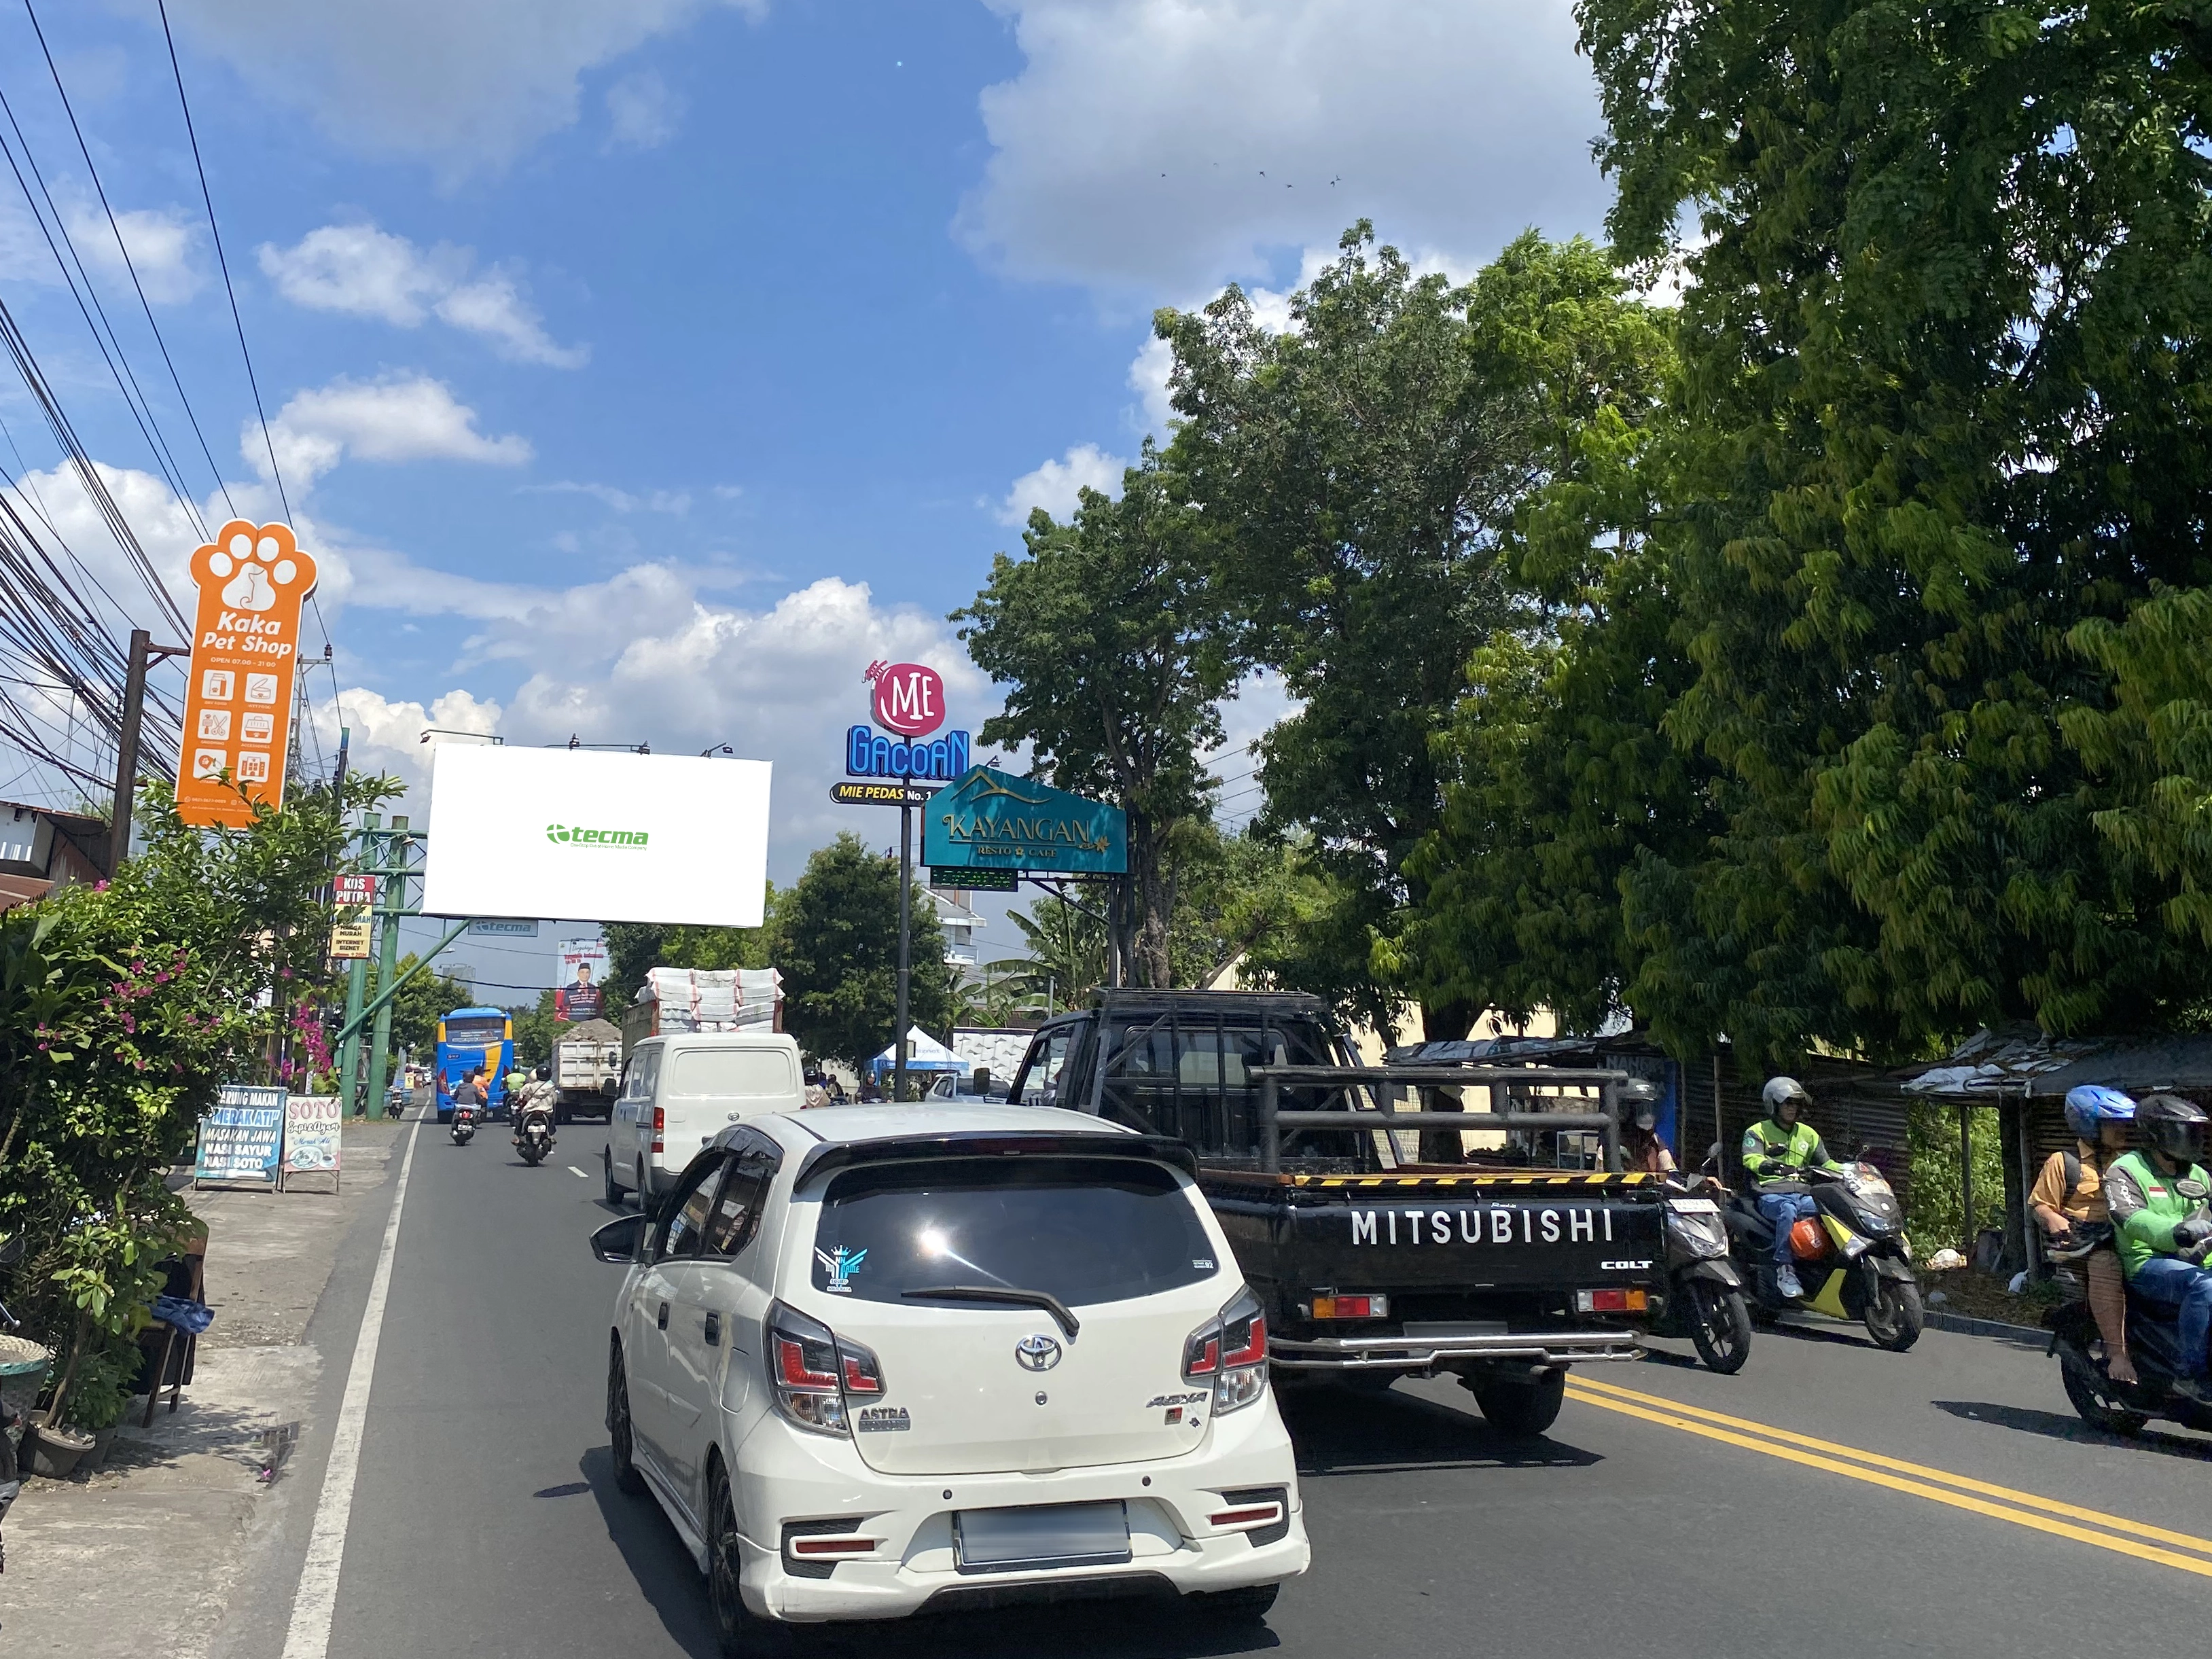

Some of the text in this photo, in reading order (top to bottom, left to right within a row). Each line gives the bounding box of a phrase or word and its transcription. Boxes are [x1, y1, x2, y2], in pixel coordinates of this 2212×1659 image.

[217, 611, 281, 636] Kaka
[202, 632, 292, 659] Pet Shop
[851, 726, 968, 777] GACOAN
[839, 785, 863, 798] MIE
[865, 787, 904, 800] PEDAS
[571, 827, 649, 845] tecma
[943, 815, 1089, 842] KAYANGAN
[978, 846, 1057, 857] RESTO CAFE
[343, 878, 365, 890] KOS
[336, 891, 371, 903] PUTRA
[489, 922, 531, 932] tecma
[219, 1091, 279, 1107] ARUNG MAKAN
[289, 1101, 340, 1120] SOTO
[205, 1128, 276, 1143] MASAKAN JAWA
[205, 1143, 272, 1156] NASI SAYUR
[204, 1156, 264, 1169] NASI SOTO
[1351, 1208, 1613, 1245] MITSUBISHI
[1601, 1261, 1653, 1270] COLT
